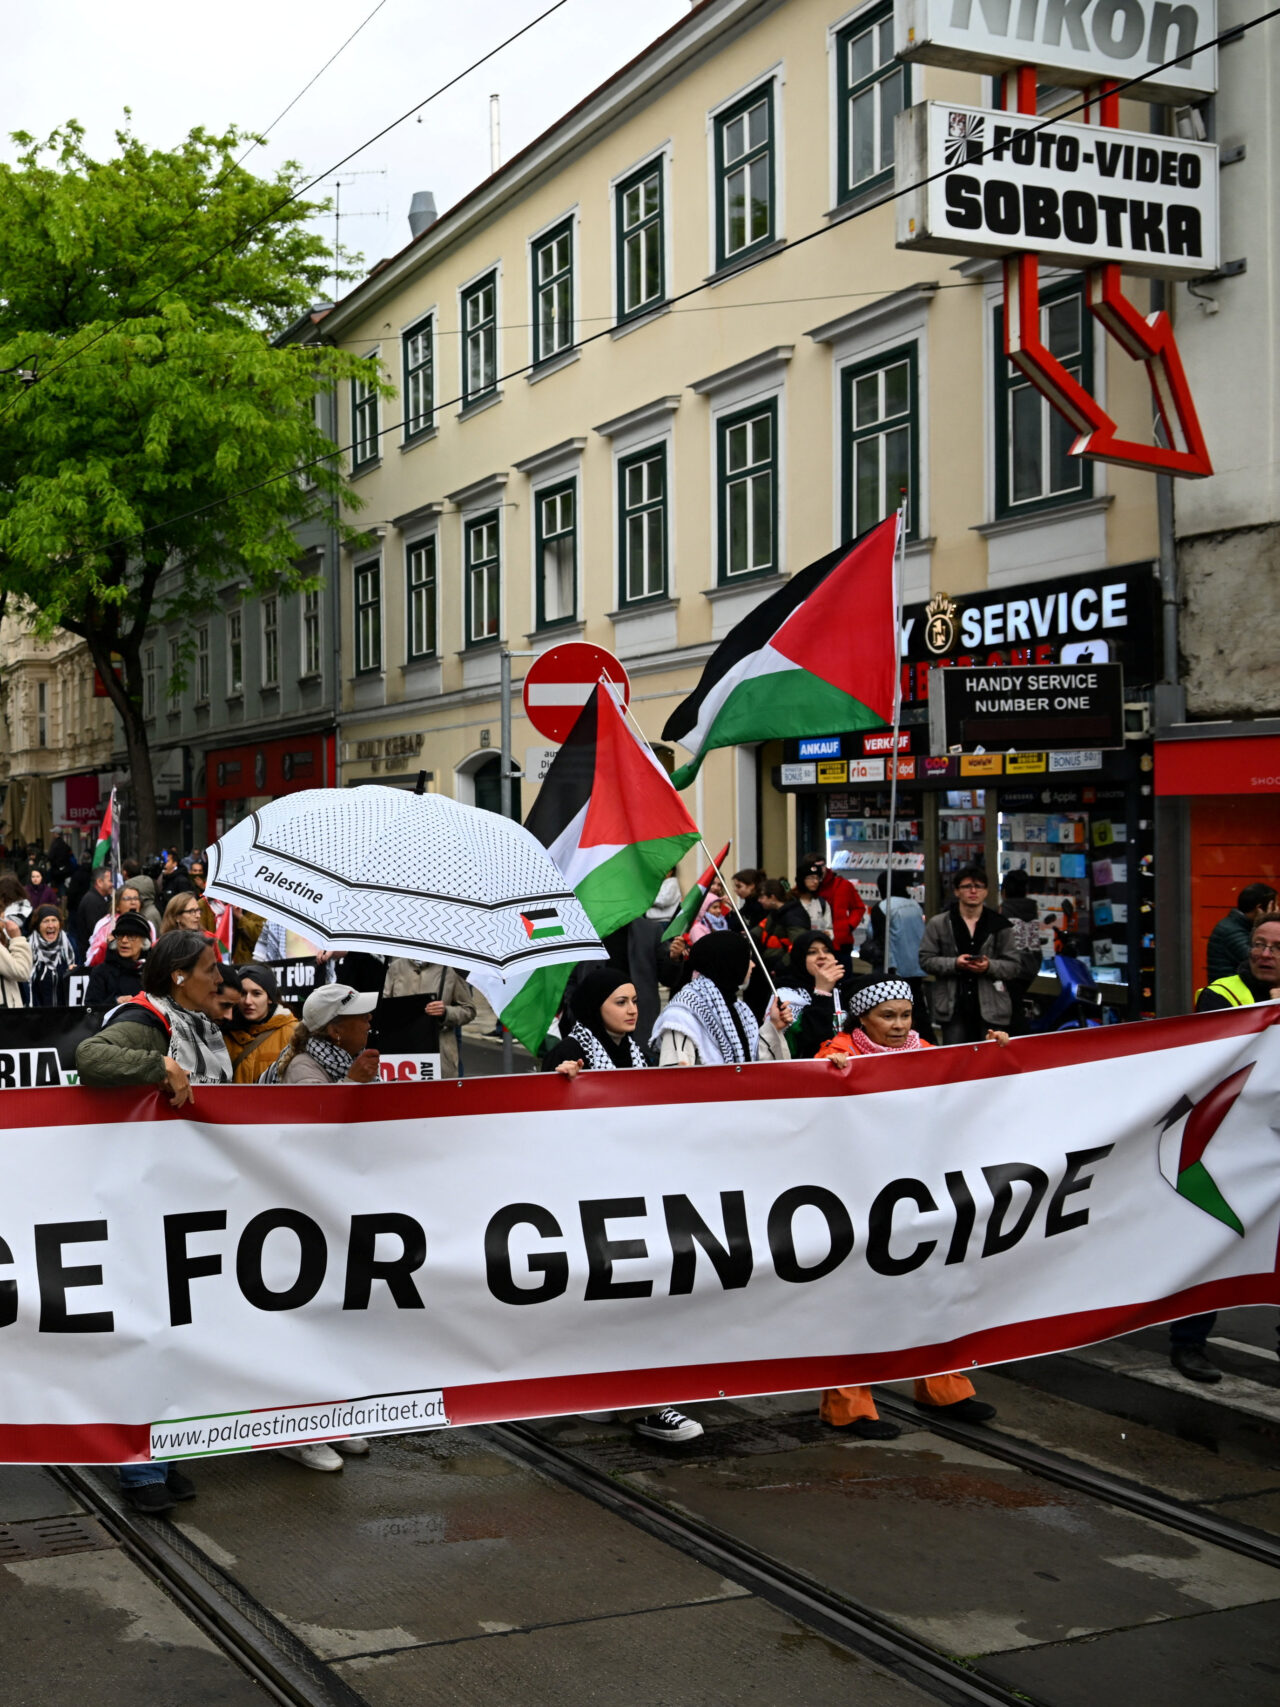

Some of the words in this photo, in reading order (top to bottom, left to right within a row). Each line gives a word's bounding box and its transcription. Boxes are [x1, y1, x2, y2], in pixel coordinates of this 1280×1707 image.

[950, 0, 1199, 70] Nikon
[993, 126, 1201, 189] FOTO-VIDEO
[945, 174, 1202, 258] SOBOTKA
[961, 583, 1127, 648] SERVICE
[966, 676, 1023, 692] HANDY
[1028, 674, 1098, 690] SERVICE
[975, 699, 1049, 713] NUMBER
[1054, 697, 1090, 709] ONE
[799, 741, 840, 756] ANKAUF
[851, 762, 868, 777] ria
[899, 762, 914, 776] dpd
[1053, 791, 1078, 803] Apple
[69, 807, 97, 819] BIPA
[255, 866, 323, 904] Palestine
[287, 962, 315, 987] FÜR
[164, 1207, 428, 1327] FOR
[484, 1143, 1115, 1306] GENOCIDE
[150, 1396, 444, 1450] www.palaestinasolidaritaet.at
